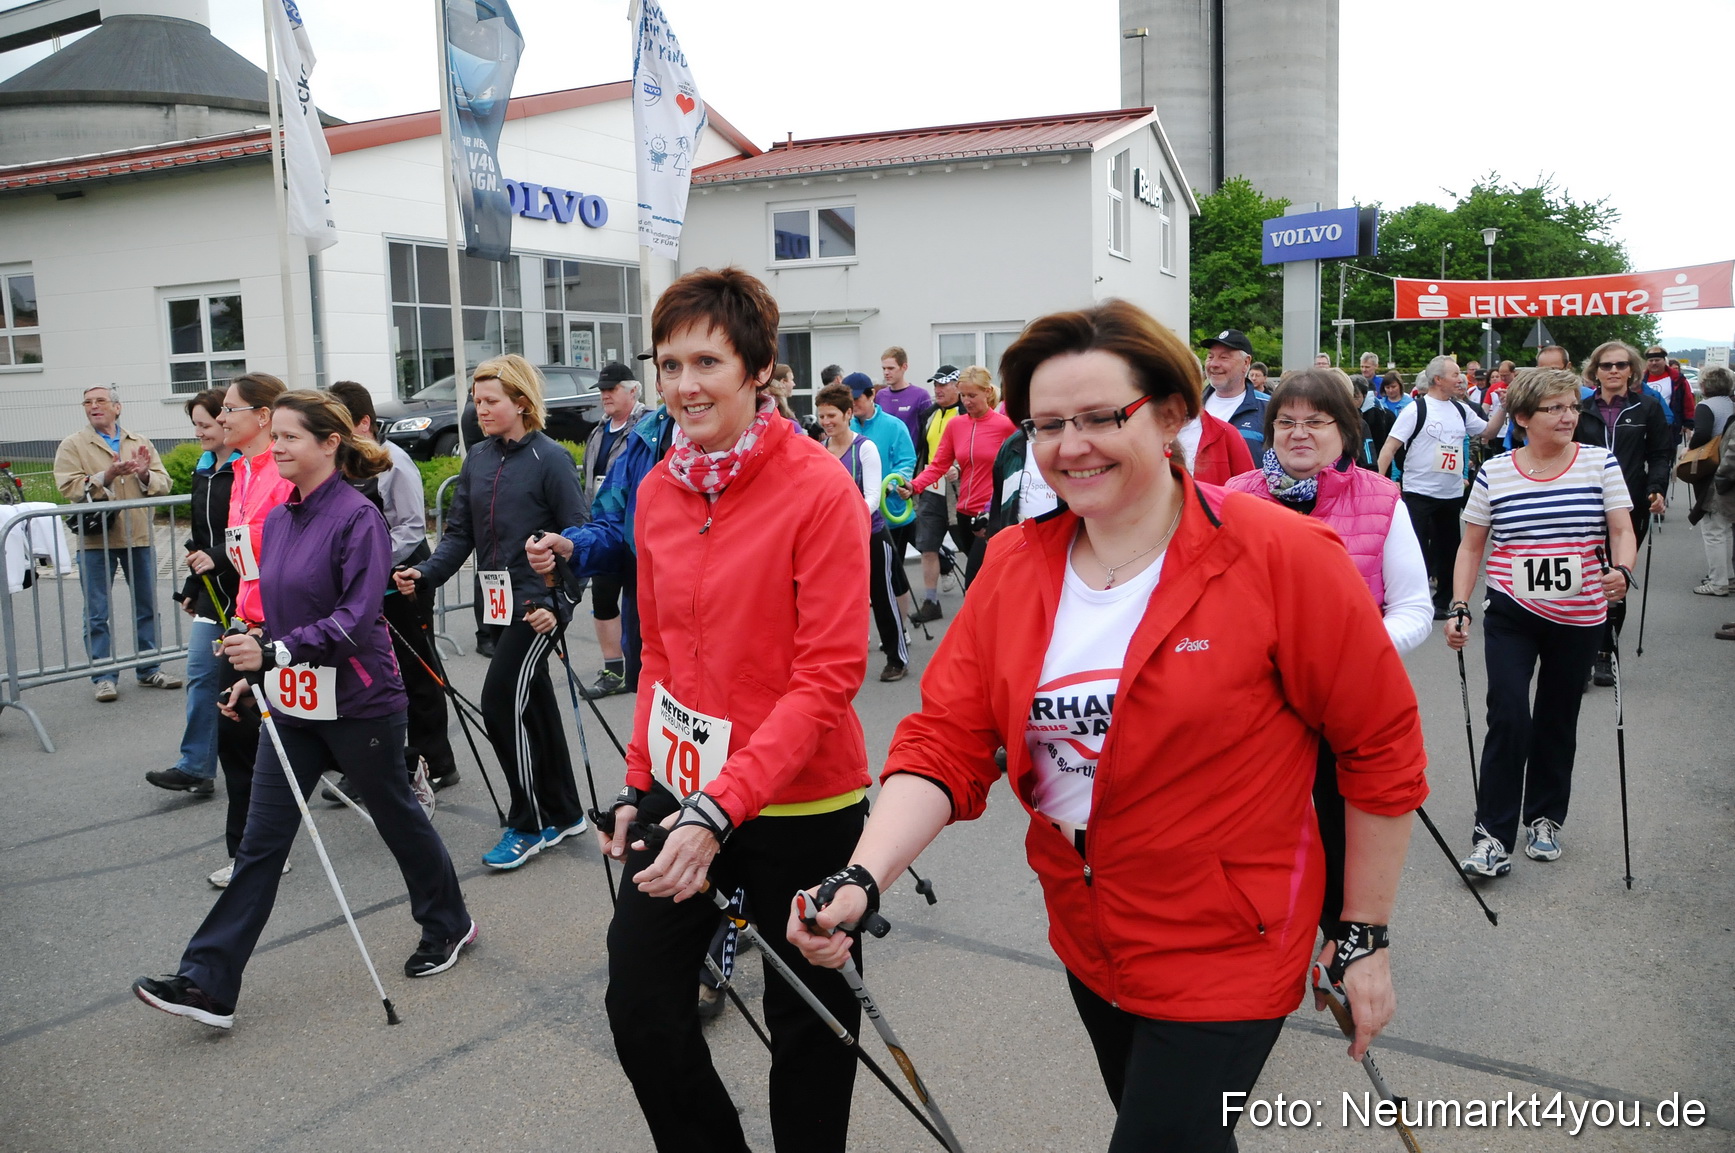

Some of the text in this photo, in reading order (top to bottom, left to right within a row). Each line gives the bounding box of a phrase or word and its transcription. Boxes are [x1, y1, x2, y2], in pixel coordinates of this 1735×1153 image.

[1269, 223, 1343, 248] VOLVO
[1441, 452, 1457, 471] 75
[1523, 557, 1572, 592] 145
[489, 588, 507, 620] 54
[279, 667, 318, 712] 93
[659, 706, 691, 736] WERBUNG
[661, 695, 690, 727] MEYER
[661, 725, 701, 799] 79
[1338, 924, 1361, 961] LEKI
